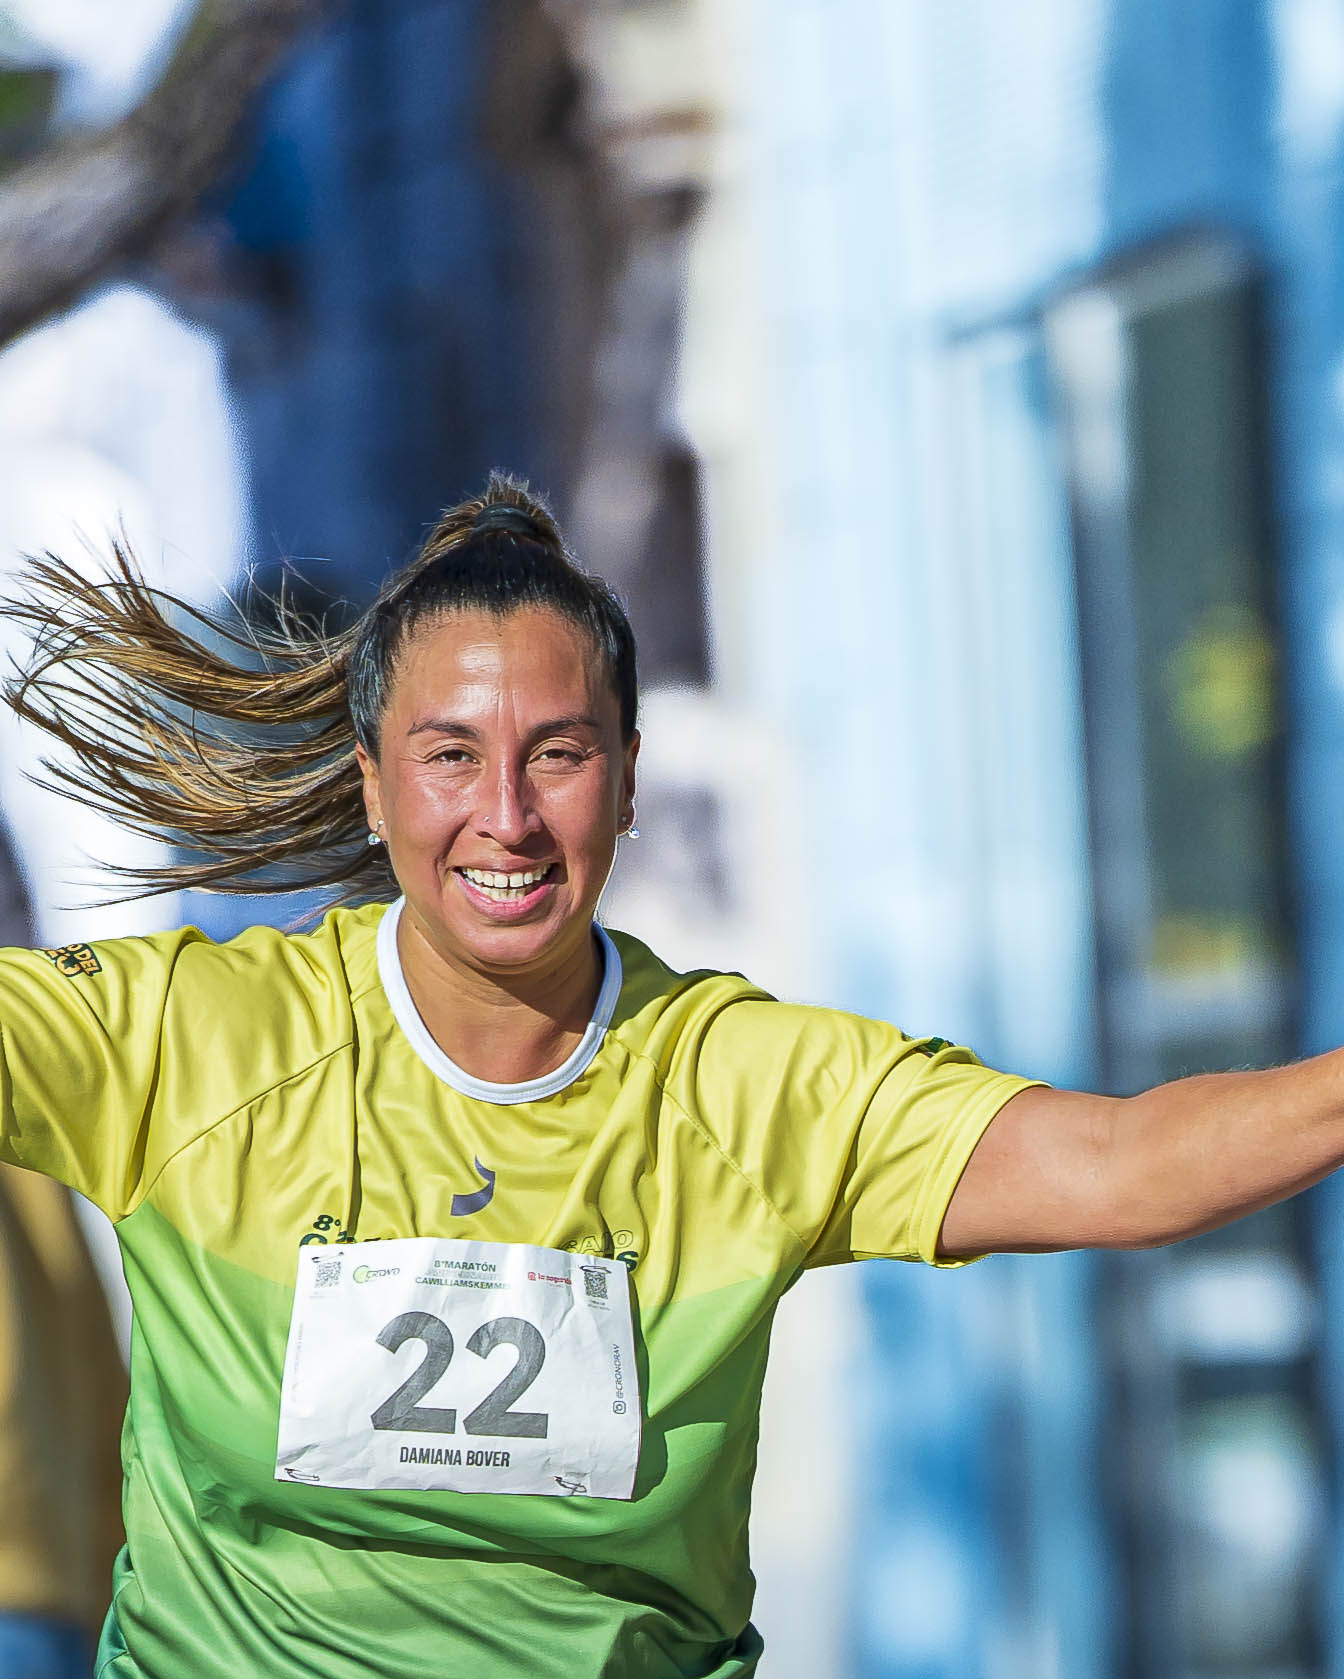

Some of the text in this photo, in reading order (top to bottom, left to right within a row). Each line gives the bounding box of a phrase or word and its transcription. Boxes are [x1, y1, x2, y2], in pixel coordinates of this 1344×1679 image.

[370, 1311, 549, 1439] 22
[399, 1446, 511, 1468] DAMIANA BOVER
